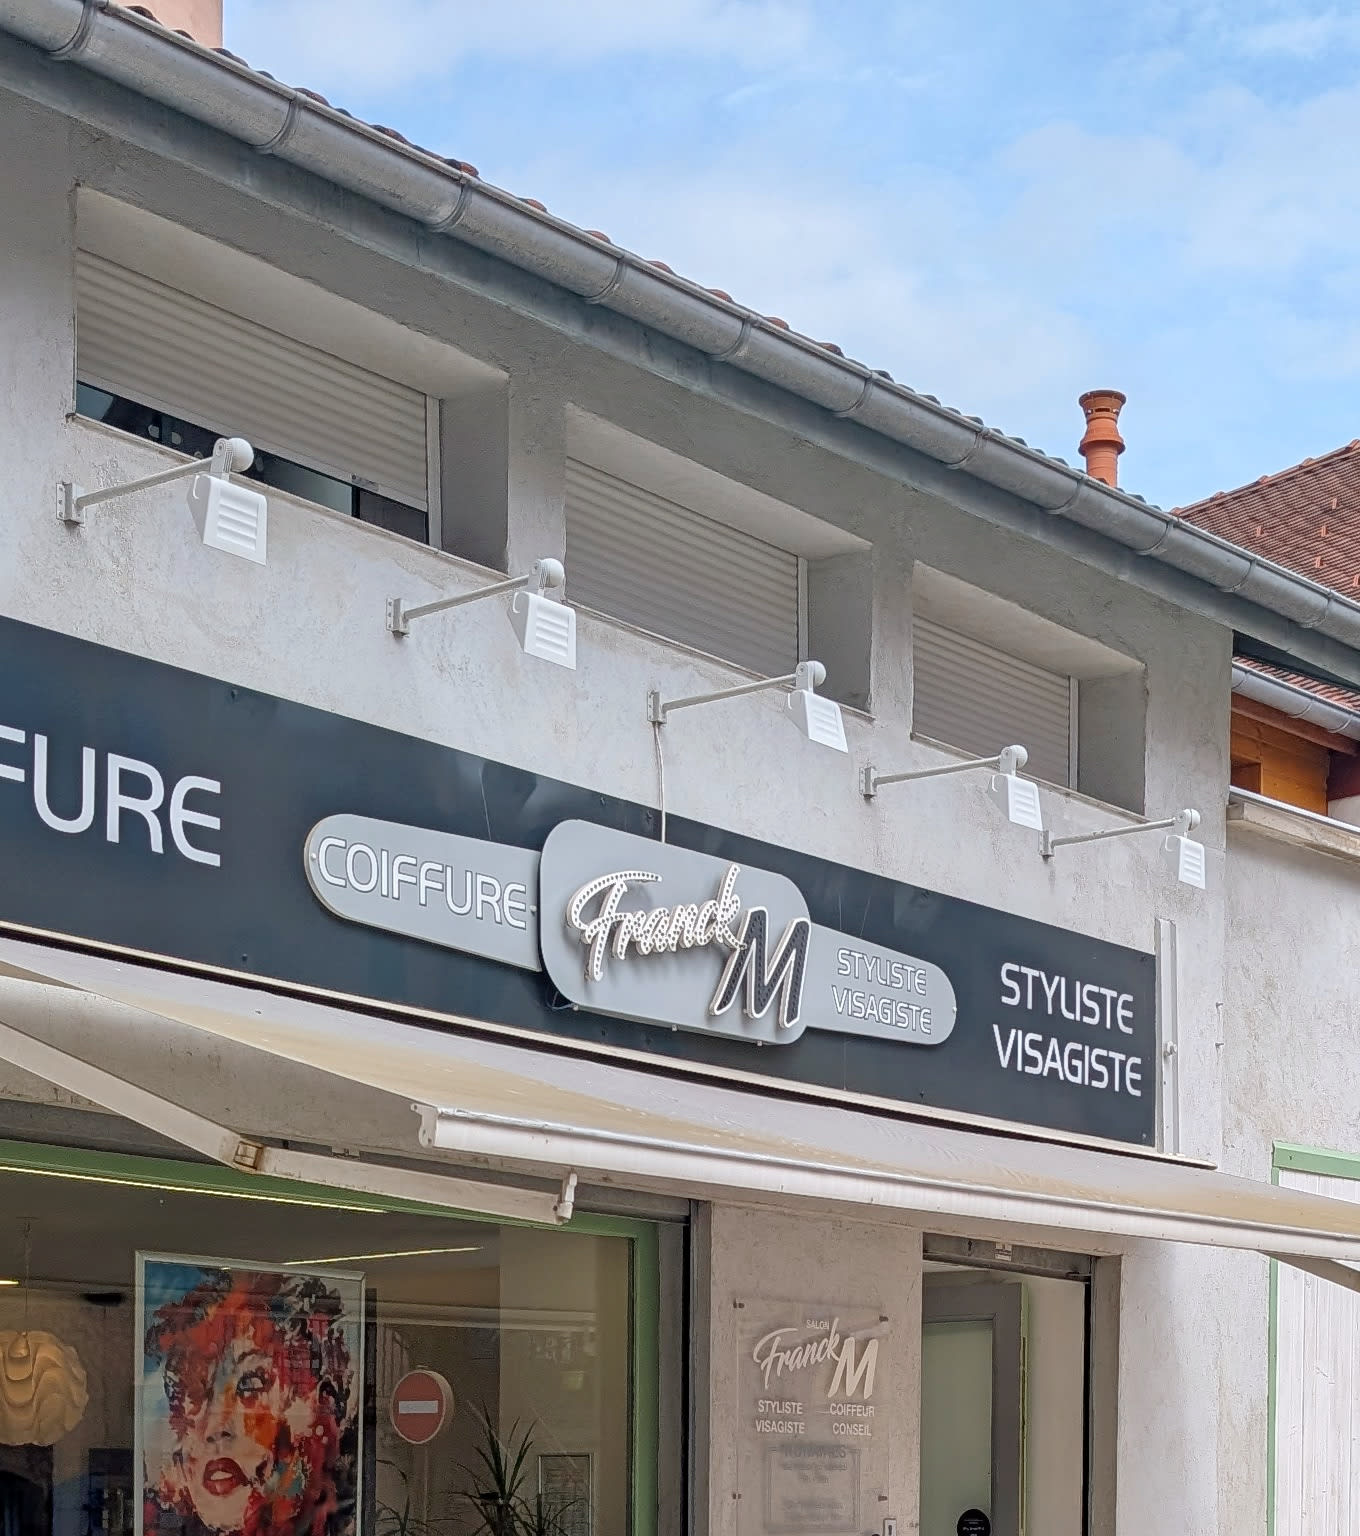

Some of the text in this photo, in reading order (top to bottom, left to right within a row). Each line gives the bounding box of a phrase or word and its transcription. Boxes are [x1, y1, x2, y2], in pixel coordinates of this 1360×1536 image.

[317, 835, 527, 930] COIFFURE
[566, 864, 811, 1029] Franck M
[837, 948, 927, 996] STYLISTE
[831, 985, 932, 1035] VISAGISTE
[1000, 962, 1134, 1035] STYLISTE
[992, 1024, 1142, 1097] VISAGISTE
[806, 1319, 830, 1330] SALON
[753, 1317, 879, 1399] Franck M
[755, 1419, 806, 1434] VISAGISTE
[758, 1400, 803, 1415] STYLISTE
[829, 1403, 875, 1417] COIFFEUR
[832, 1422, 872, 1436] CONSEIL
